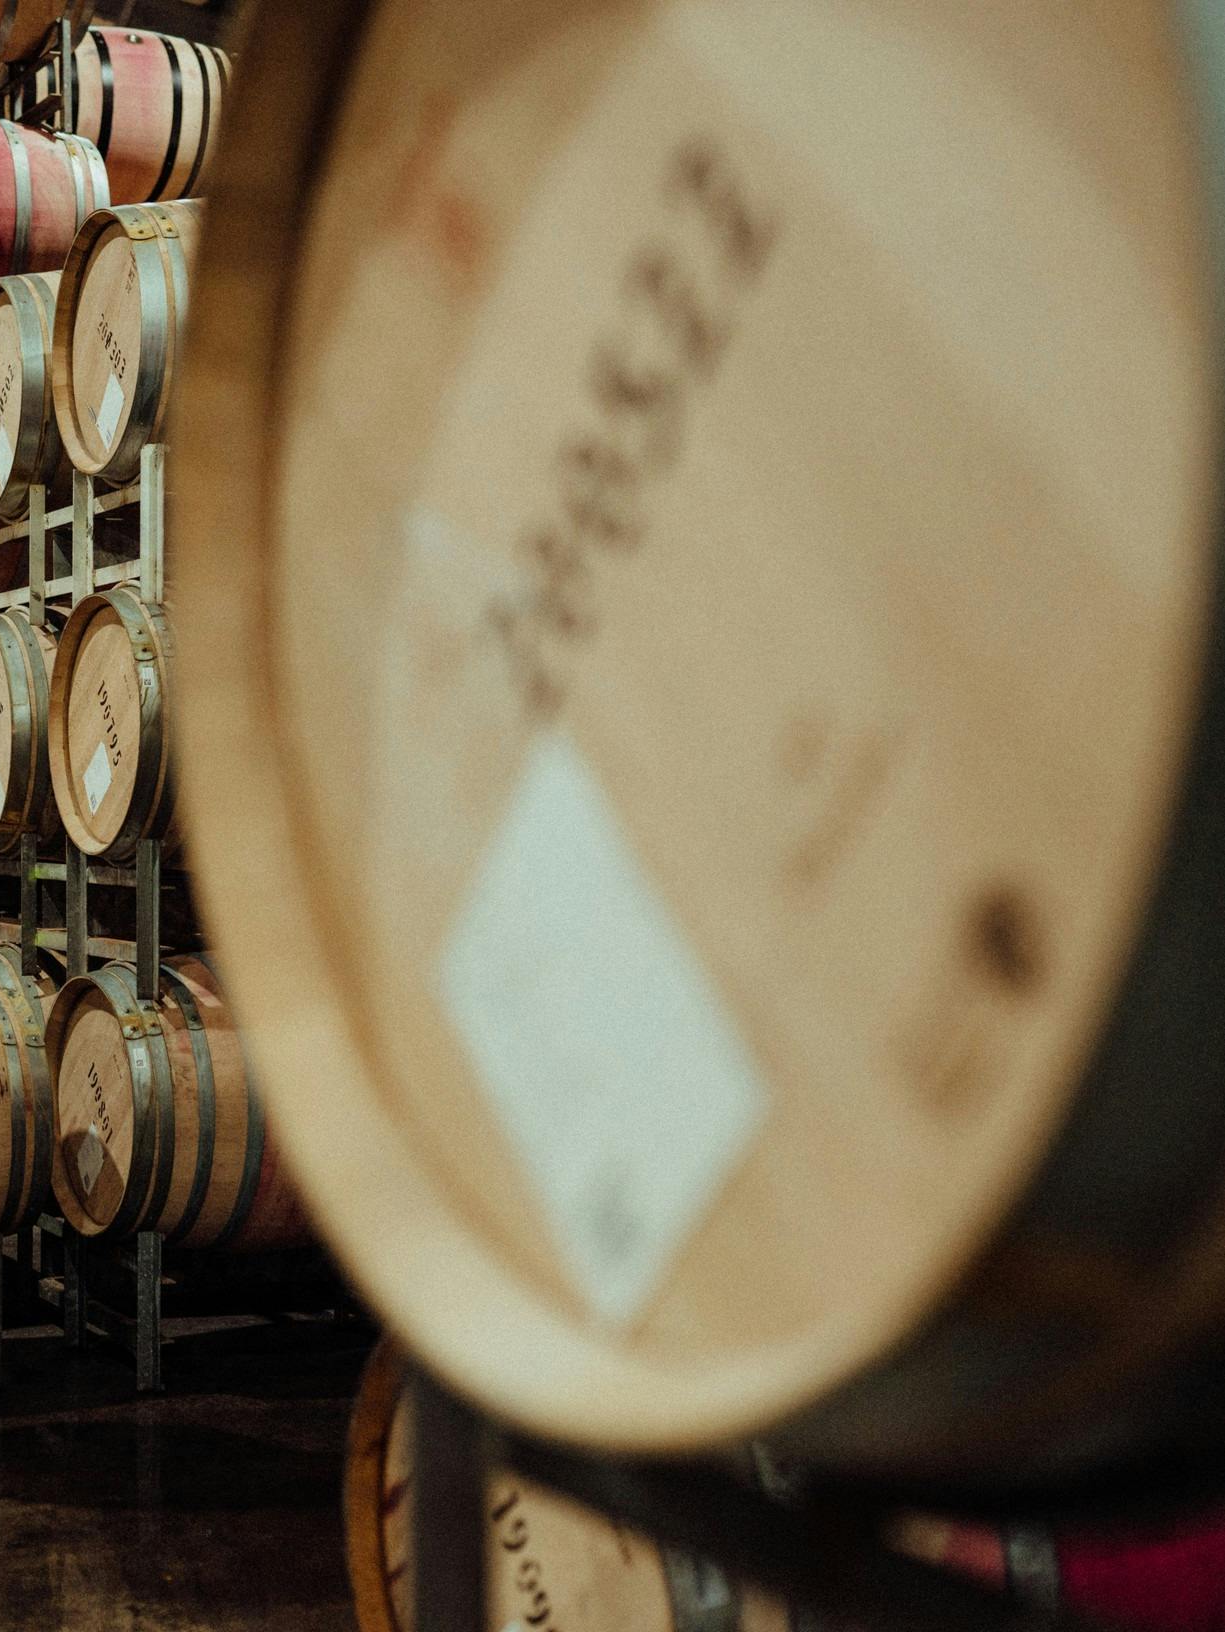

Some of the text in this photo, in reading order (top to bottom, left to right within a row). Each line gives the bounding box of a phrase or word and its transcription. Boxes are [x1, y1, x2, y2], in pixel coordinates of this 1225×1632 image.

[97, 679, 122, 767] 190795
[88, 1062, 113, 1144] 190801
[492, 1491, 559, 1632] 1909
